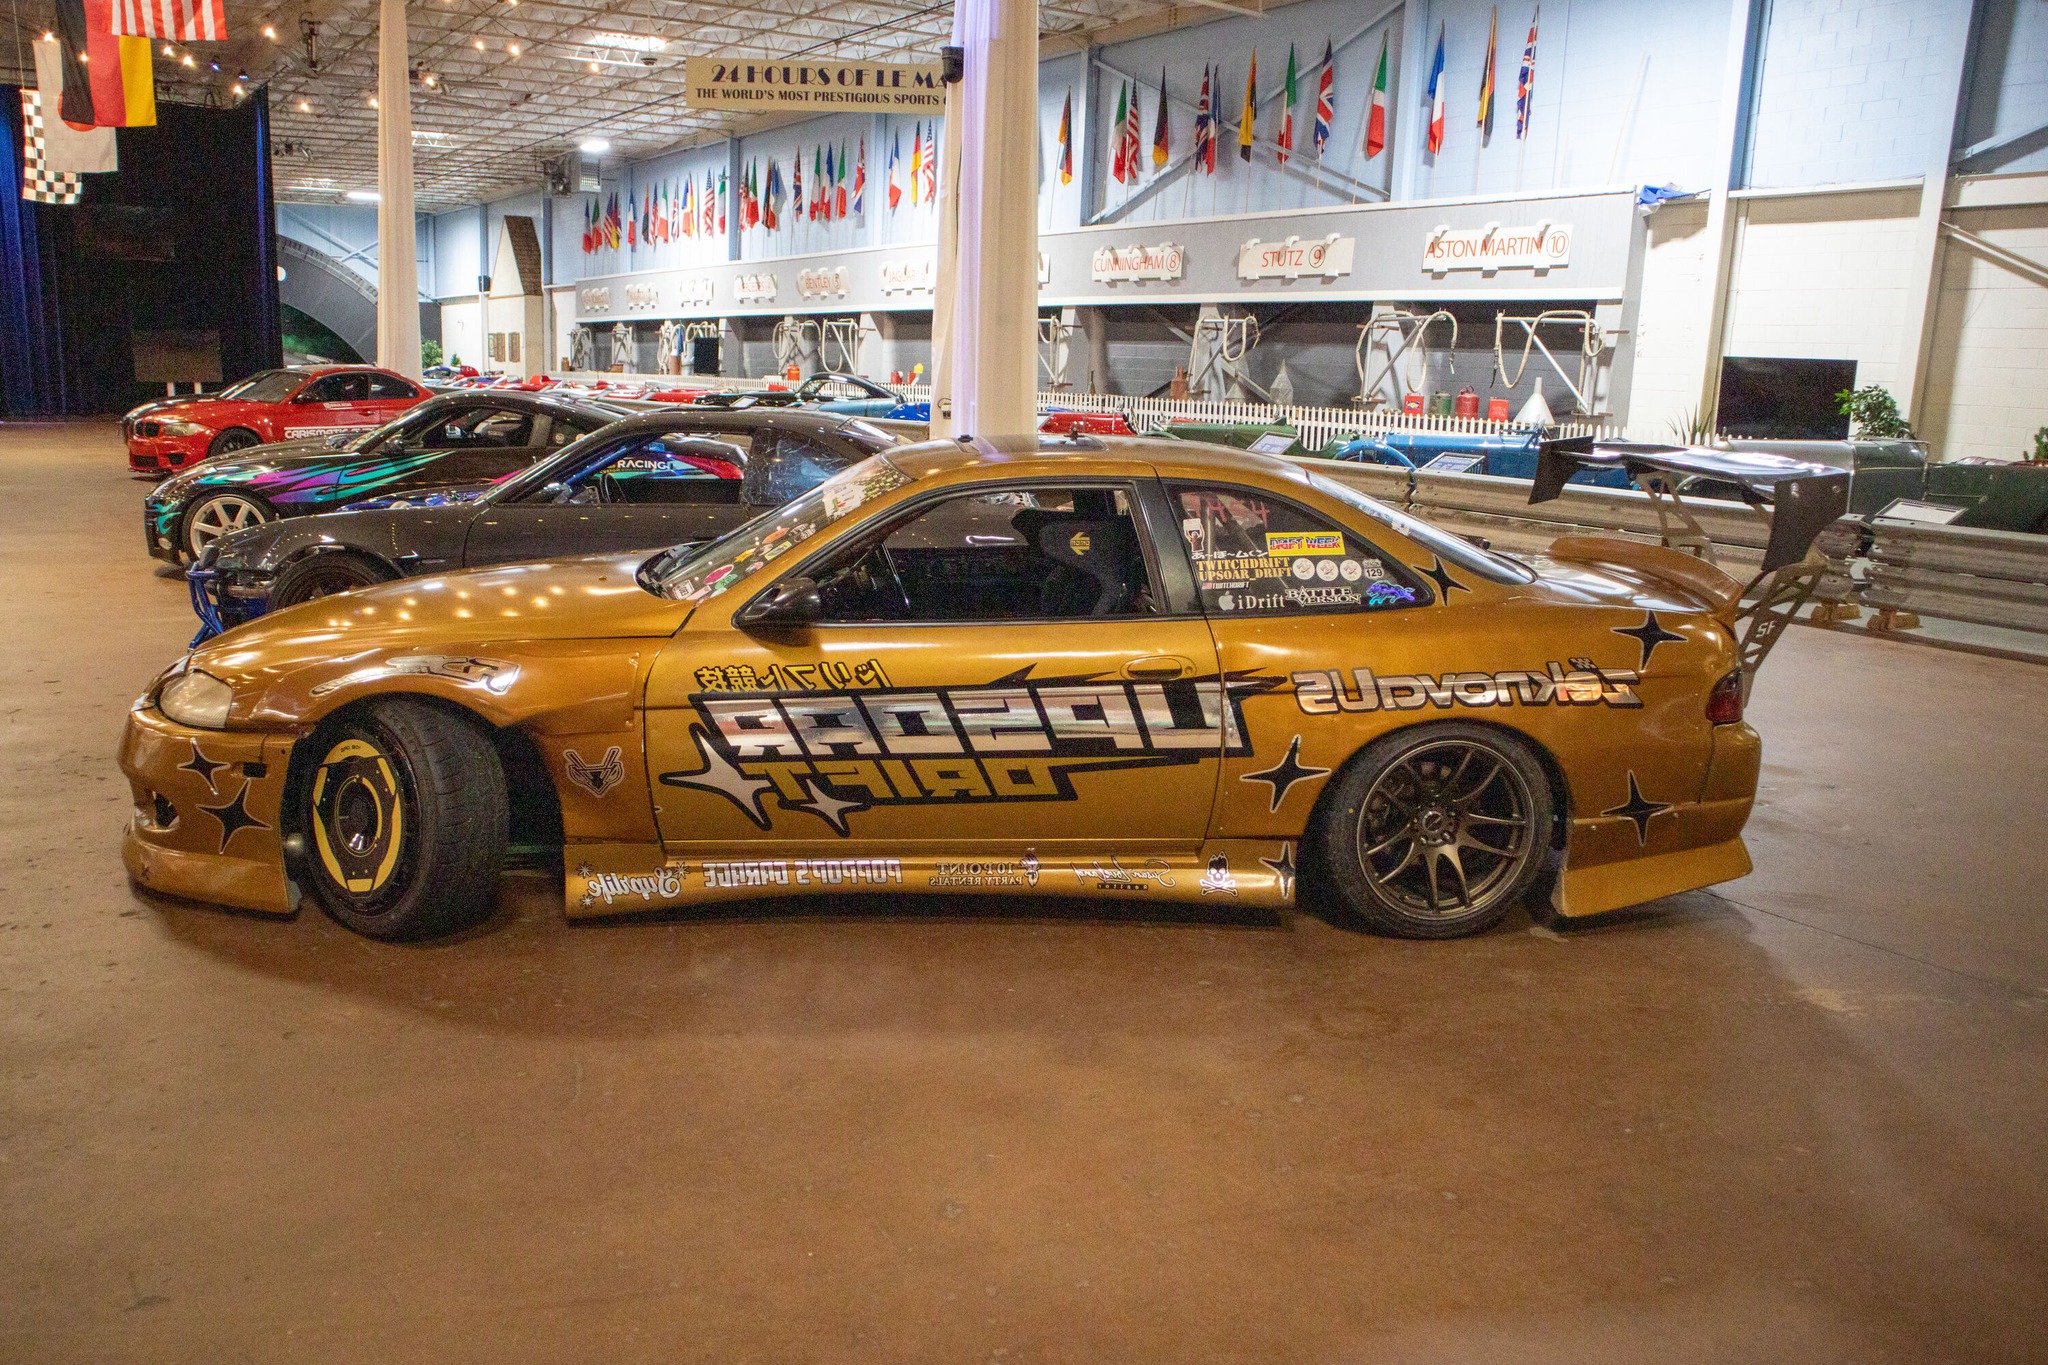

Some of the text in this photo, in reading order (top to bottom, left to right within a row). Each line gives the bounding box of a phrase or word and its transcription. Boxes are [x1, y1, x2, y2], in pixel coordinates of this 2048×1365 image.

[711, 65, 948, 89] 24 HOURS OF LE MA
[695, 88, 718, 99] THE
[722, 89, 774, 100] WORLD'S
[778, 91, 810, 101] MOST
[814, 92, 890, 104] PRESTIGIOUS
[893, 94, 939, 106] SPORTS
[1425, 234, 1567, 259] ASTON MARTIN 10
[1094, 254, 1165, 273] CUNNINGHAM
[1261, 250, 1304, 268] STUTZ
[805, 276, 831, 290] BENTLEY
[617, 459, 666, 470] RACING
[1269, 535, 1341, 551] DRIFT WEEK
[1196, 557, 1290, 571] TWITCHDRIFT
[1199, 567, 1292, 581] UPSOAR_DRIFT
[1367, 568, 1383, 577] 129
[1287, 587, 1351, 599] BATTLE
[1238, 593, 1285, 610] iDrift
[1299, 596, 1361, 606] VERSION
